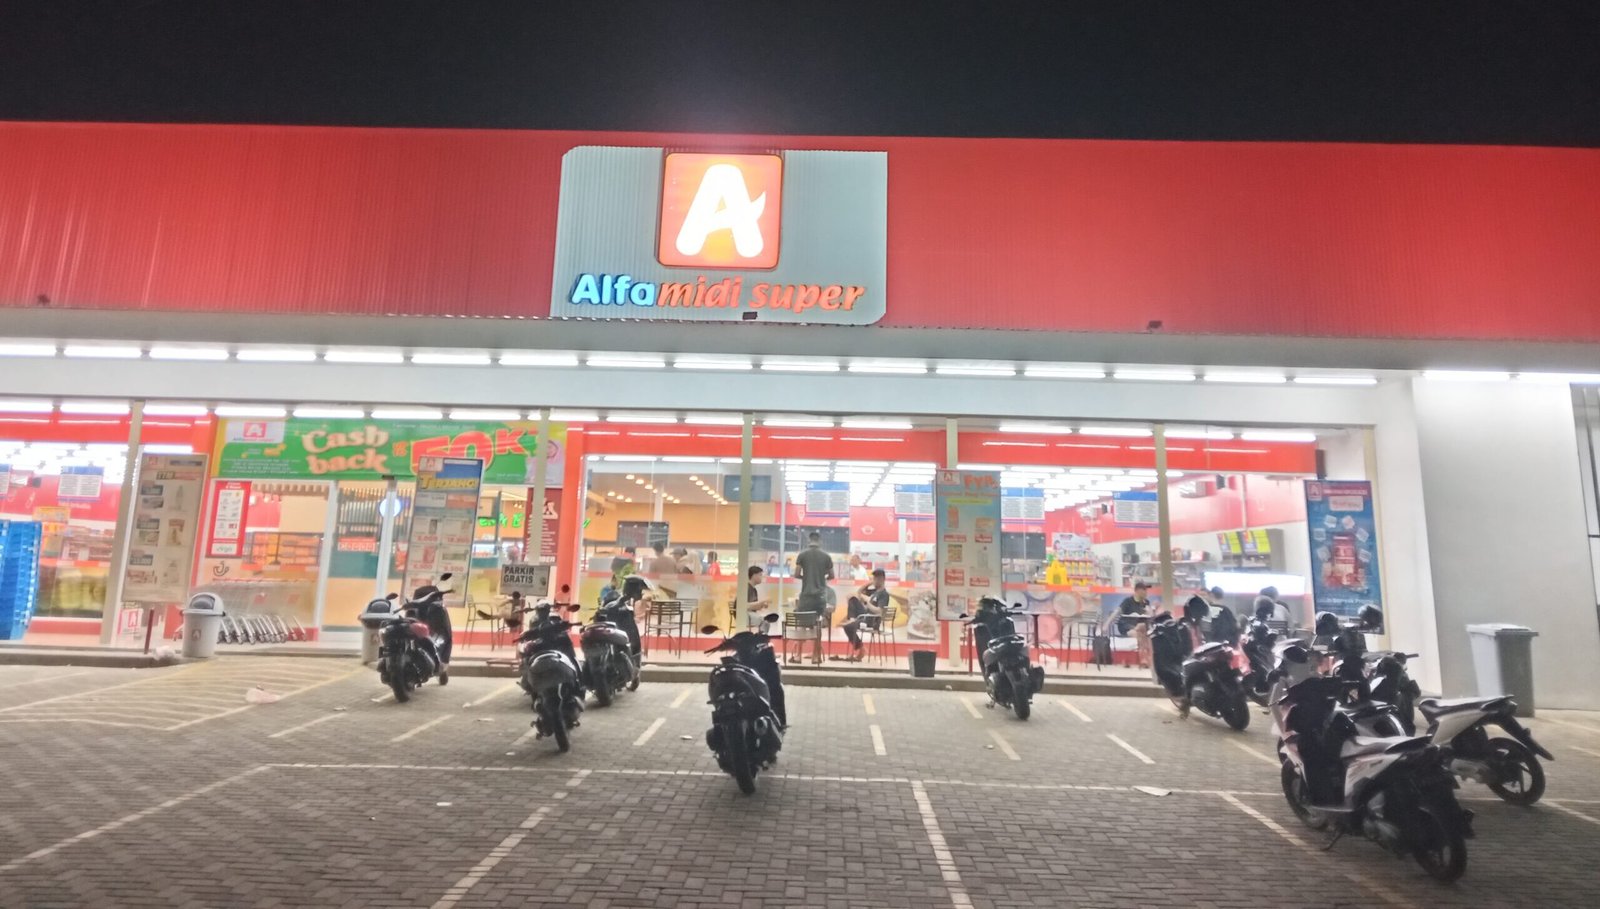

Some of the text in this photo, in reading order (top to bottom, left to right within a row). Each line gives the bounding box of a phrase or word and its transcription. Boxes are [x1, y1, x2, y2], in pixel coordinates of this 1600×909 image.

[676, 163, 767, 258] A
[569, 273, 865, 314] Alfamidi super
[302, 425, 389, 454] Cash
[306, 448, 391, 475] back
[503, 574, 534, 584] GRATIS
[504, 566, 535, 575] PARKIR
